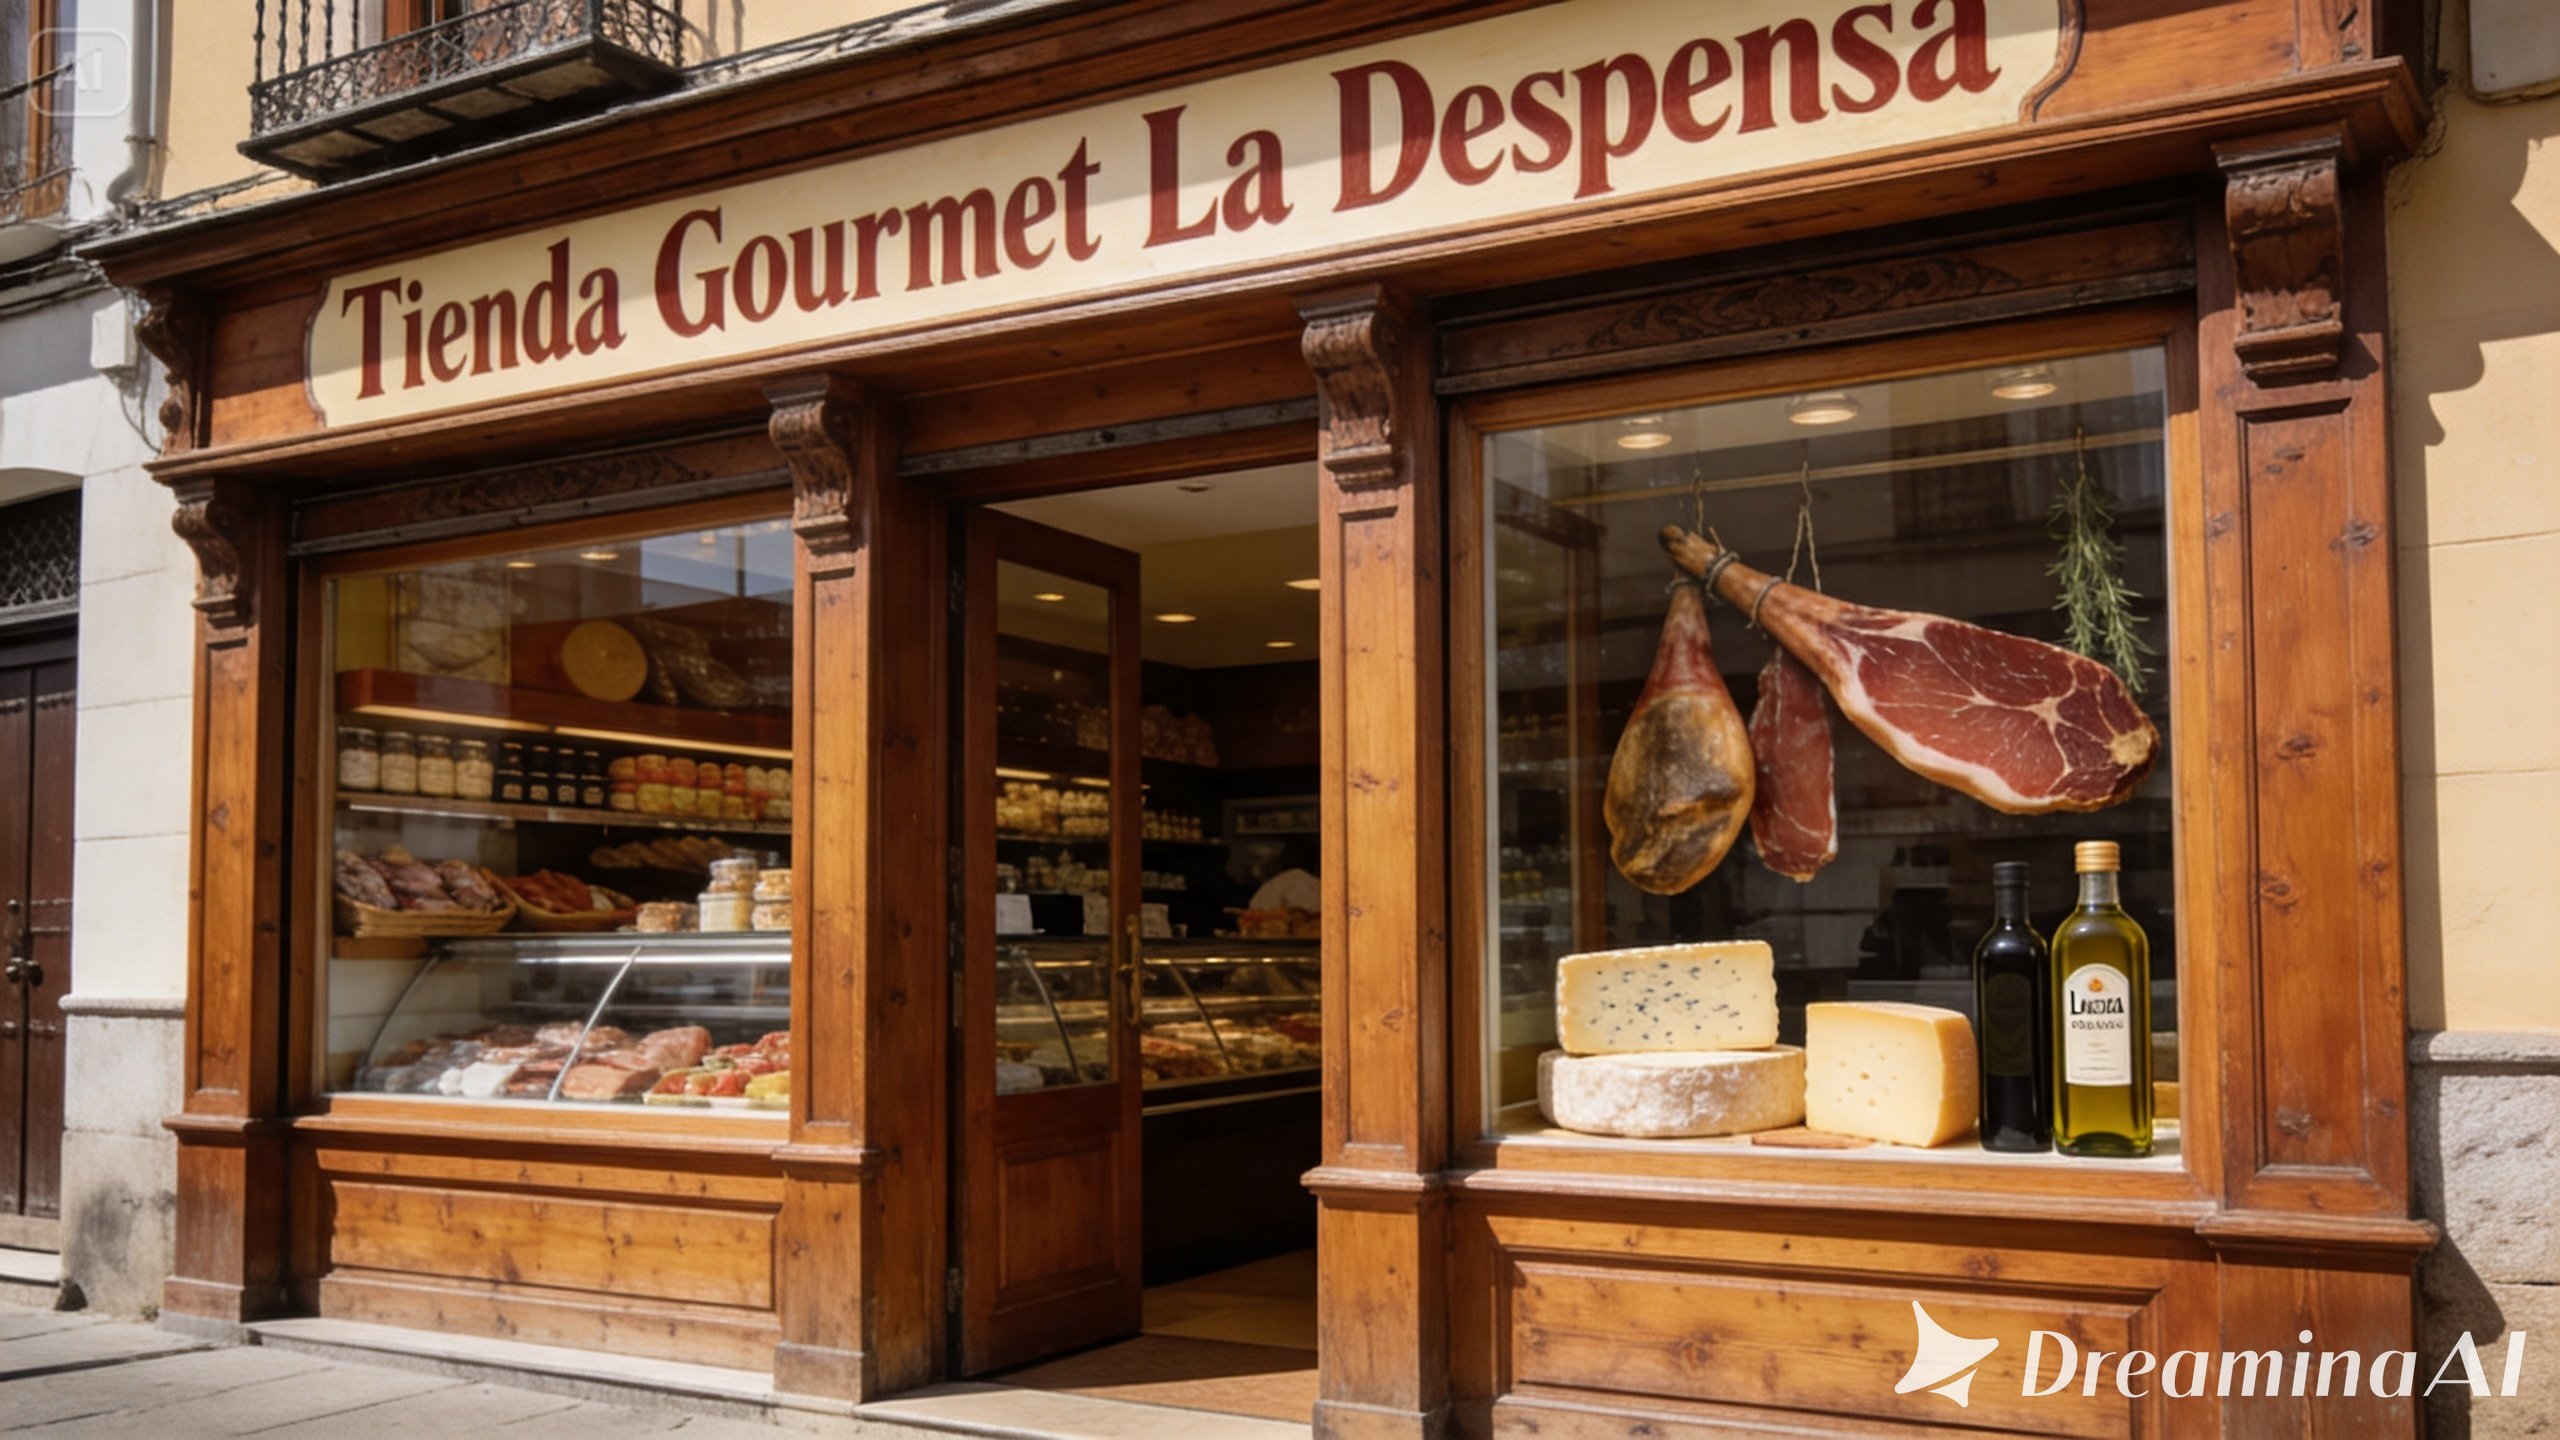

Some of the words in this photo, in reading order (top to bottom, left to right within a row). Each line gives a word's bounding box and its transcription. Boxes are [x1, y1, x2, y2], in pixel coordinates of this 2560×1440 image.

[342, 236, 627, 400] Tienda
[653, 136, 1102, 340] Gourmet
[1142, 105, 1294, 249] La
[1330, 0, 2001, 213] Despensa
